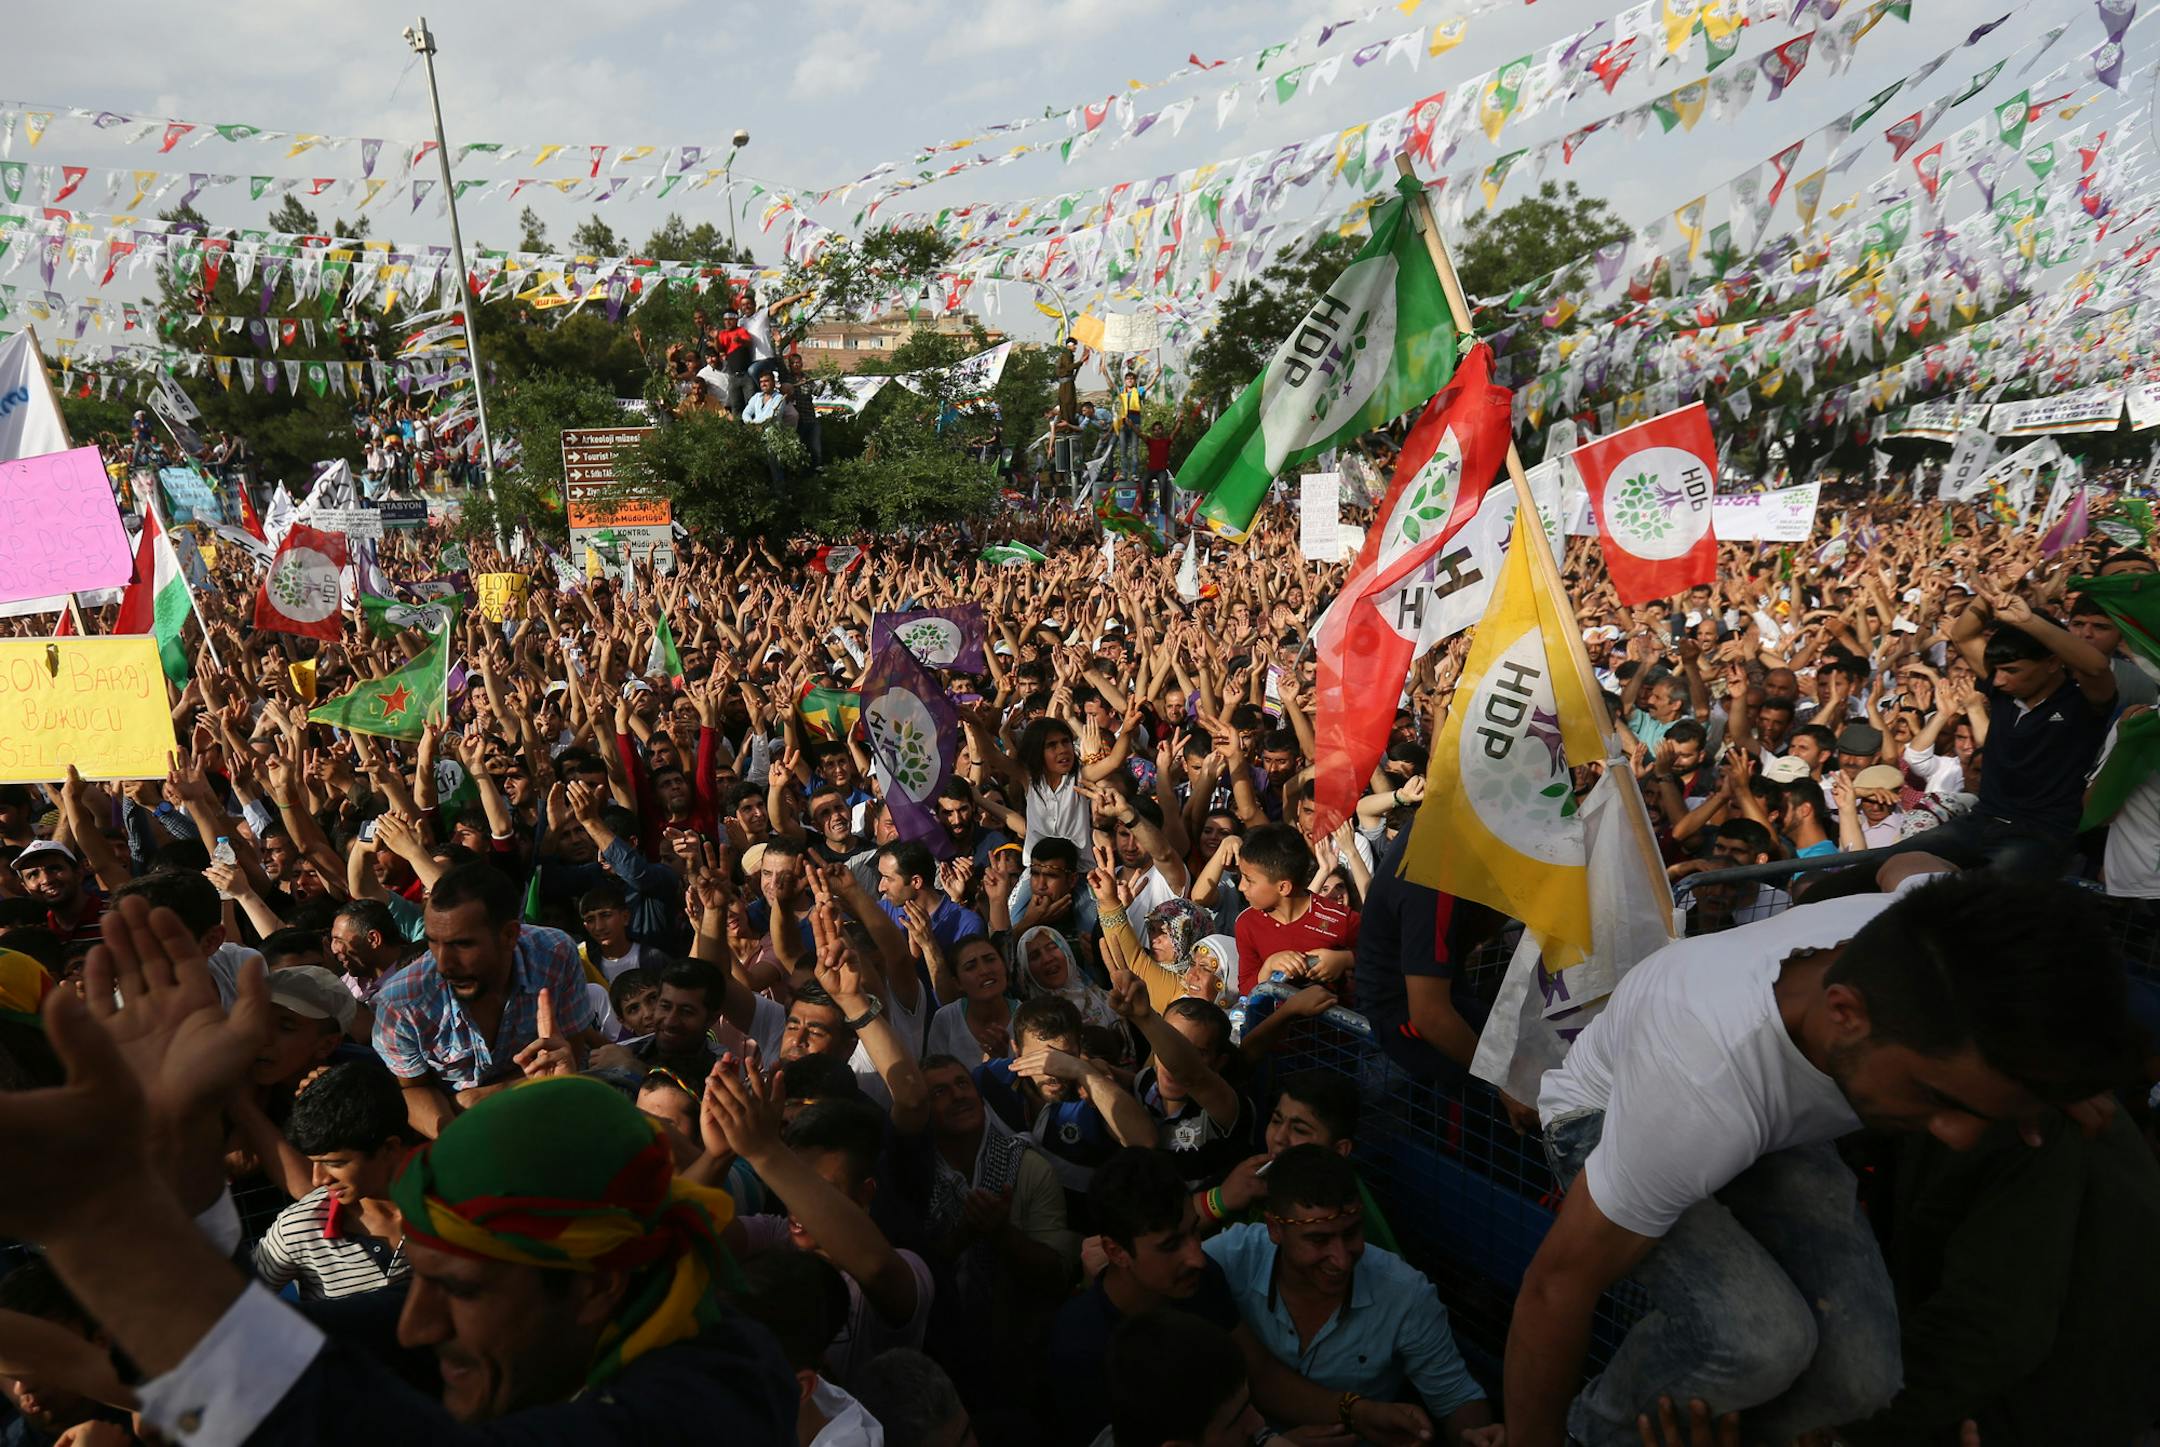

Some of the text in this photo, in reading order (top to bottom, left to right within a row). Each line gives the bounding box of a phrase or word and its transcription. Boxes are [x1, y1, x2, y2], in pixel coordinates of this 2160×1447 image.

[1284, 294, 1351, 387] HDP
[582, 436, 614, 447] Arkeoloji
[583, 452, 609, 461] Tourist
[617, 526, 651, 536] KONTROL
[322, 574, 337, 605] HDP
[1476, 661, 1541, 759] HDP
